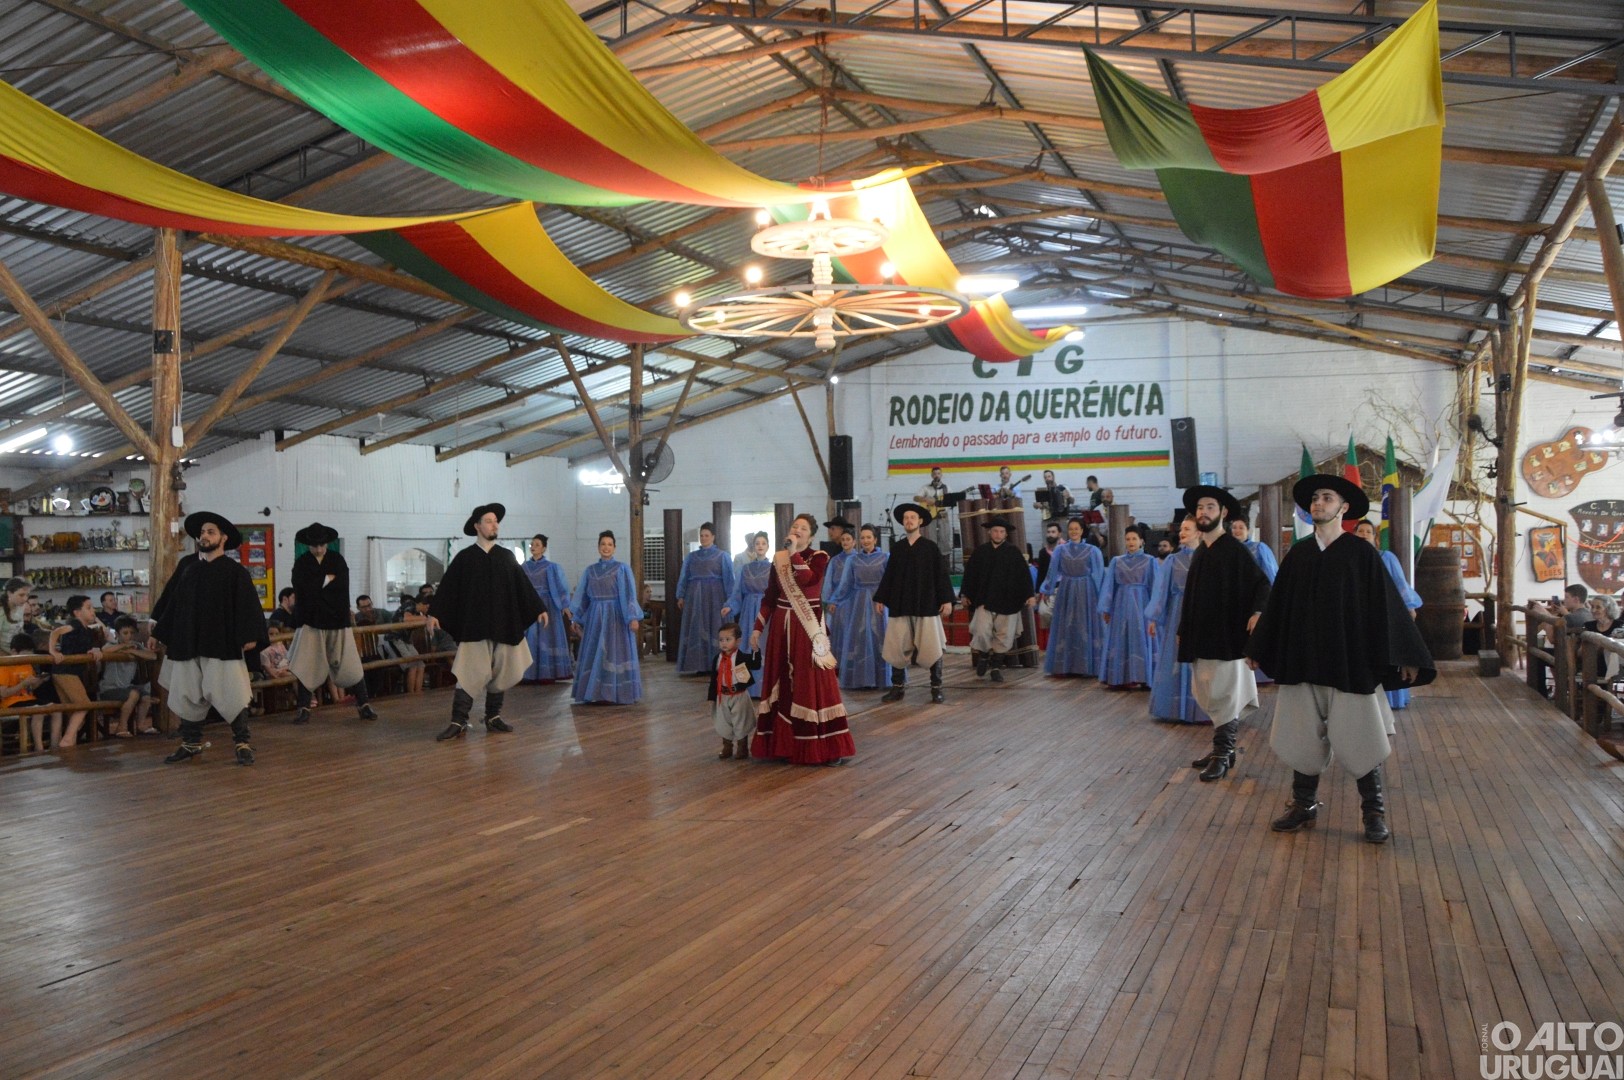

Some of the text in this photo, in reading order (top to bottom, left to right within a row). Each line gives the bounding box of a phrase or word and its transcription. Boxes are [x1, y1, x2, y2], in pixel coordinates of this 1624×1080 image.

[889, 380, 1164, 427] RODEIO DA QUERÊNCIA
[890, 425, 1162, 451] Lembrando o passado para exemplo do futuro.
